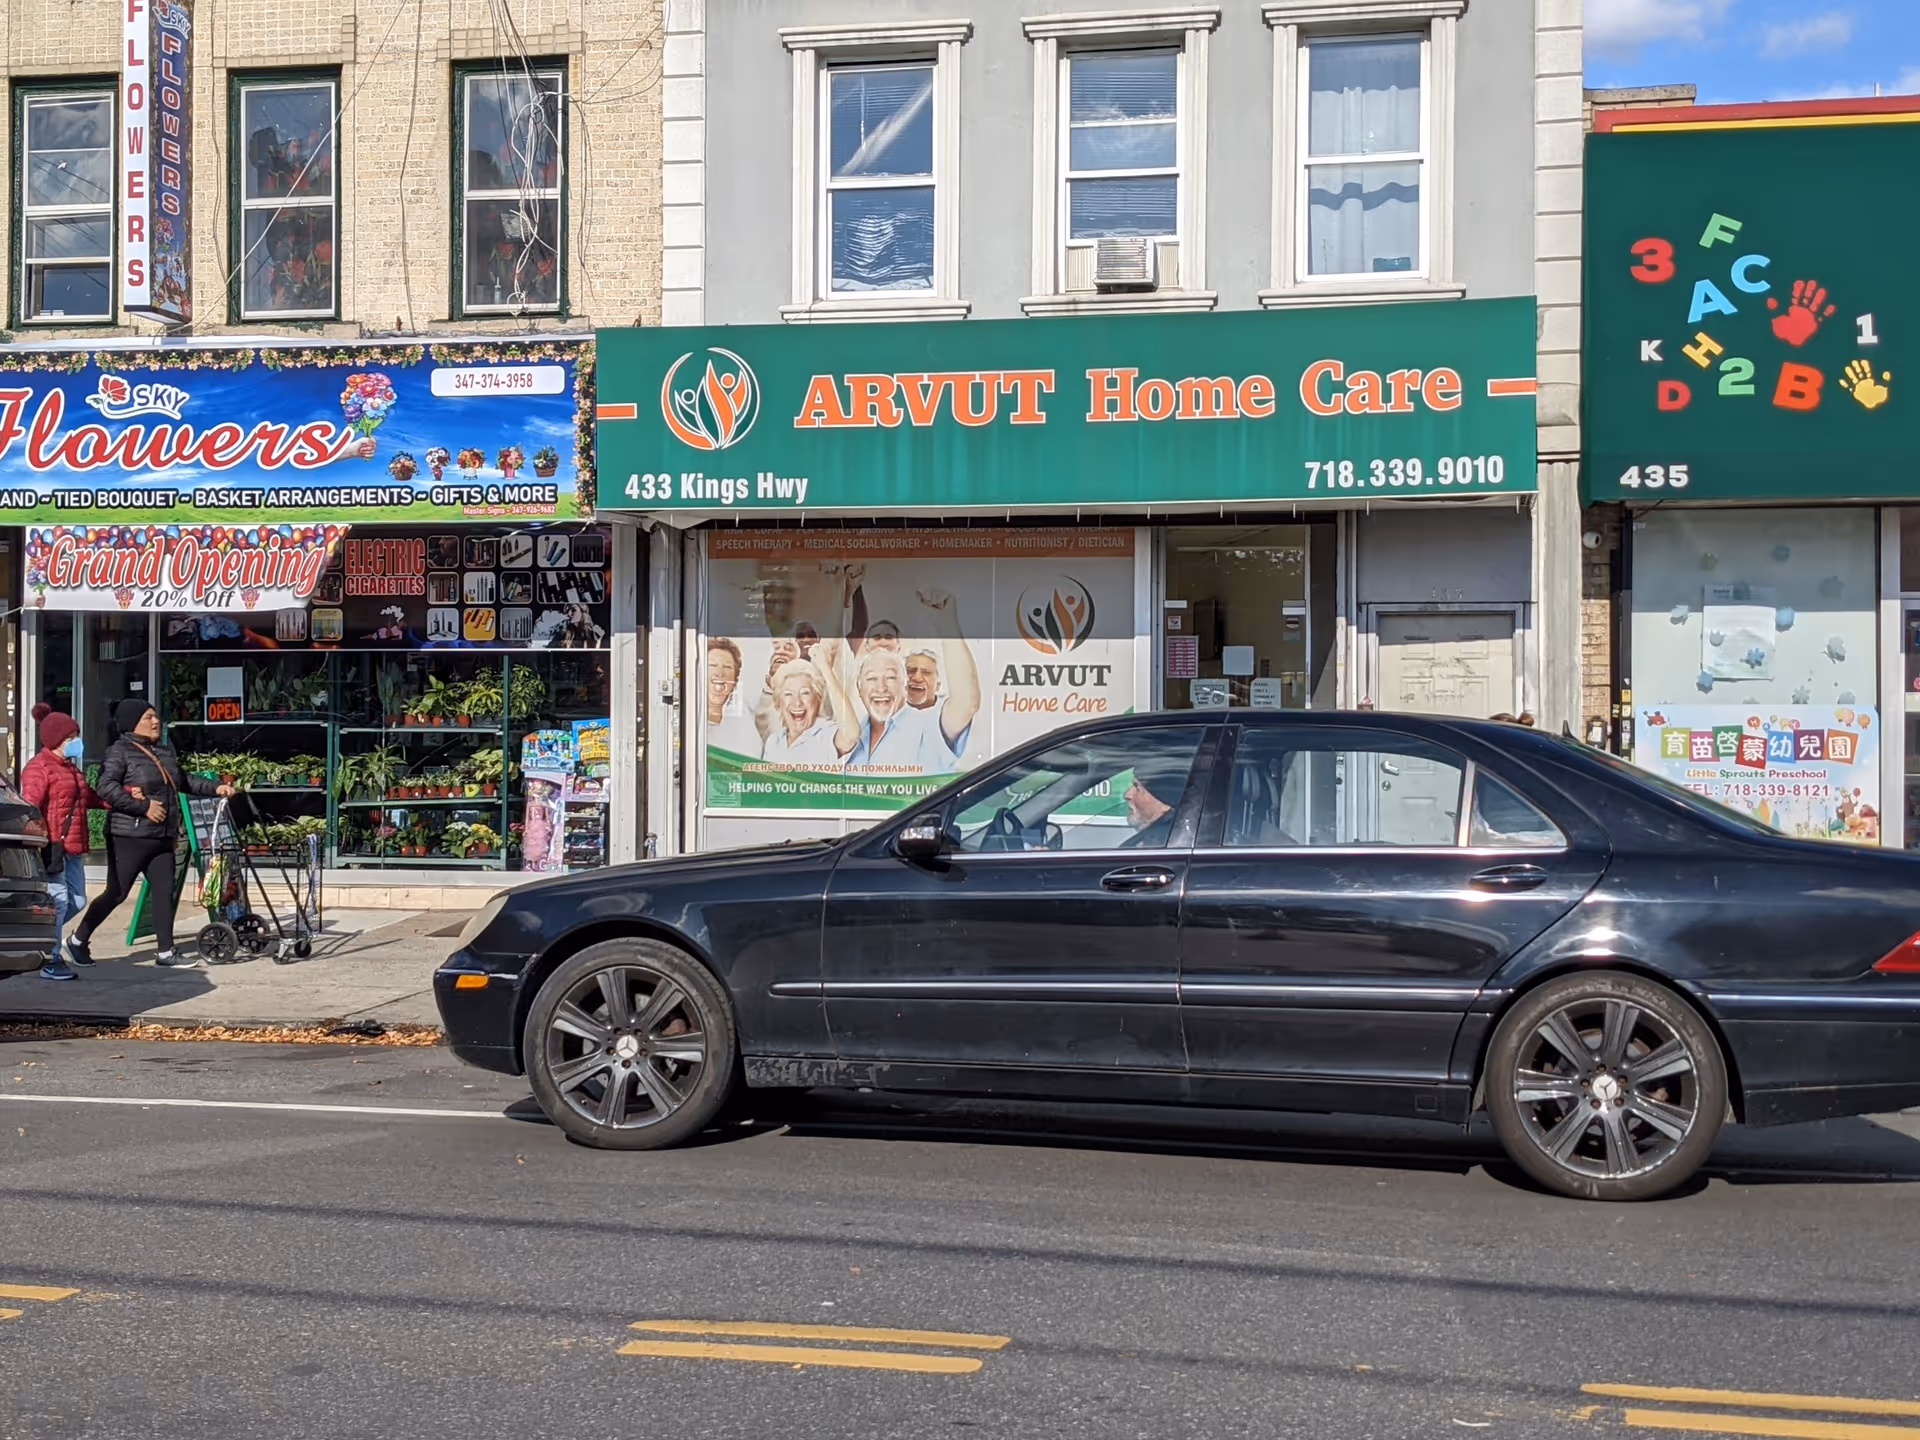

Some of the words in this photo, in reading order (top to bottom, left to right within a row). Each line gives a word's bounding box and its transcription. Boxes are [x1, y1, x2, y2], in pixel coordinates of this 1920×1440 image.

[162, 32, 181, 216] FLOWERS
[127, 0, 145, 287] FLOWERS
[1699, 213, 1743, 248] F
[1630, 238, 1675, 283] 3
[1730, 254, 1771, 293] C
[1687, 279, 1738, 323] A
[1856, 313, 1878, 344] 1
[1640, 340, 1663, 361] K
[1682, 332, 1724, 368] H
[454, 373, 533, 389] 347-374-3958
[1718, 357, 1755, 395] 2
[1772, 361, 1824, 410] B
[134, 384, 189, 411] SKY
[794, 369, 1055, 428] ARVUT
[1085, 366, 1276, 422] Home
[1299, 359, 1462, 416] Care
[1658, 380, 1691, 411] D
[1304, 455, 1504, 489] 718.339.9010
[1619, 465, 1689, 488] 435
[54, 491, 92, 507] TIED
[98, 491, 176, 507] BOUQUET
[195, 490, 262, 506] BASKET
[266, 488, 412, 506] ARRANGEMENTS
[432, 487, 482, 504] GIFTS
[487, 486, 500, 502] &
[505, 486, 556, 502] MORE
[625, 474, 672, 500] 433
[680, 473, 749, 504] Kings
[756, 472, 808, 504] Hwy
[463, 506, 486, 515] Master
[487, 505, 505, 516] Signs
[345, 539, 426, 575] ELECTRIC
[716, 539, 750, 550] SPEECH
[753, 539, 793, 549] THERAPY
[804, 538, 845, 549] MEDICAL
[847, 538, 881, 549] SOCIAL
[881, 538, 920, 548] WORKER
[932, 537, 992, 548] HOMEMAKER
[1005, 537, 1068, 547] NUTRITIONIST
[1078, 537, 1125, 547] DIETICIAN
[48, 535, 165, 588] Grand
[170, 534, 326, 601] Opening
[141, 590, 188, 608] 20%
[204, 590, 235, 608] Off
[345, 576, 426, 596] CIGARETTES
[999, 664, 1111, 687] ARVUT
[208, 703, 240, 720] OPEN
[1002, 693, 1060, 713] Home
[1063, 692, 1107, 713] Care
[743, 763, 793, 773] АГЕНСТВО
[795, 763, 809, 772] ПО
[811, 763, 842, 773] УХОДУ
[846, 764, 861, 773] ЗА
[861, 764, 923, 773] ПОЖИЛЫМИ
[1686, 769, 1717, 778] Little
[1719, 769, 1765, 779] Sprouts
[1768, 769, 1827, 778] Preschool
[728, 782, 773, 793] HELPING
[775, 783, 797, 793] YOU
[800, 783, 842, 793] CHANGE
[845, 784, 864, 794] THE
[866, 785, 888, 795] WAY
[890, 785, 912, 795] YOU
[1723, 784, 1830, 796] 718-339-8121
